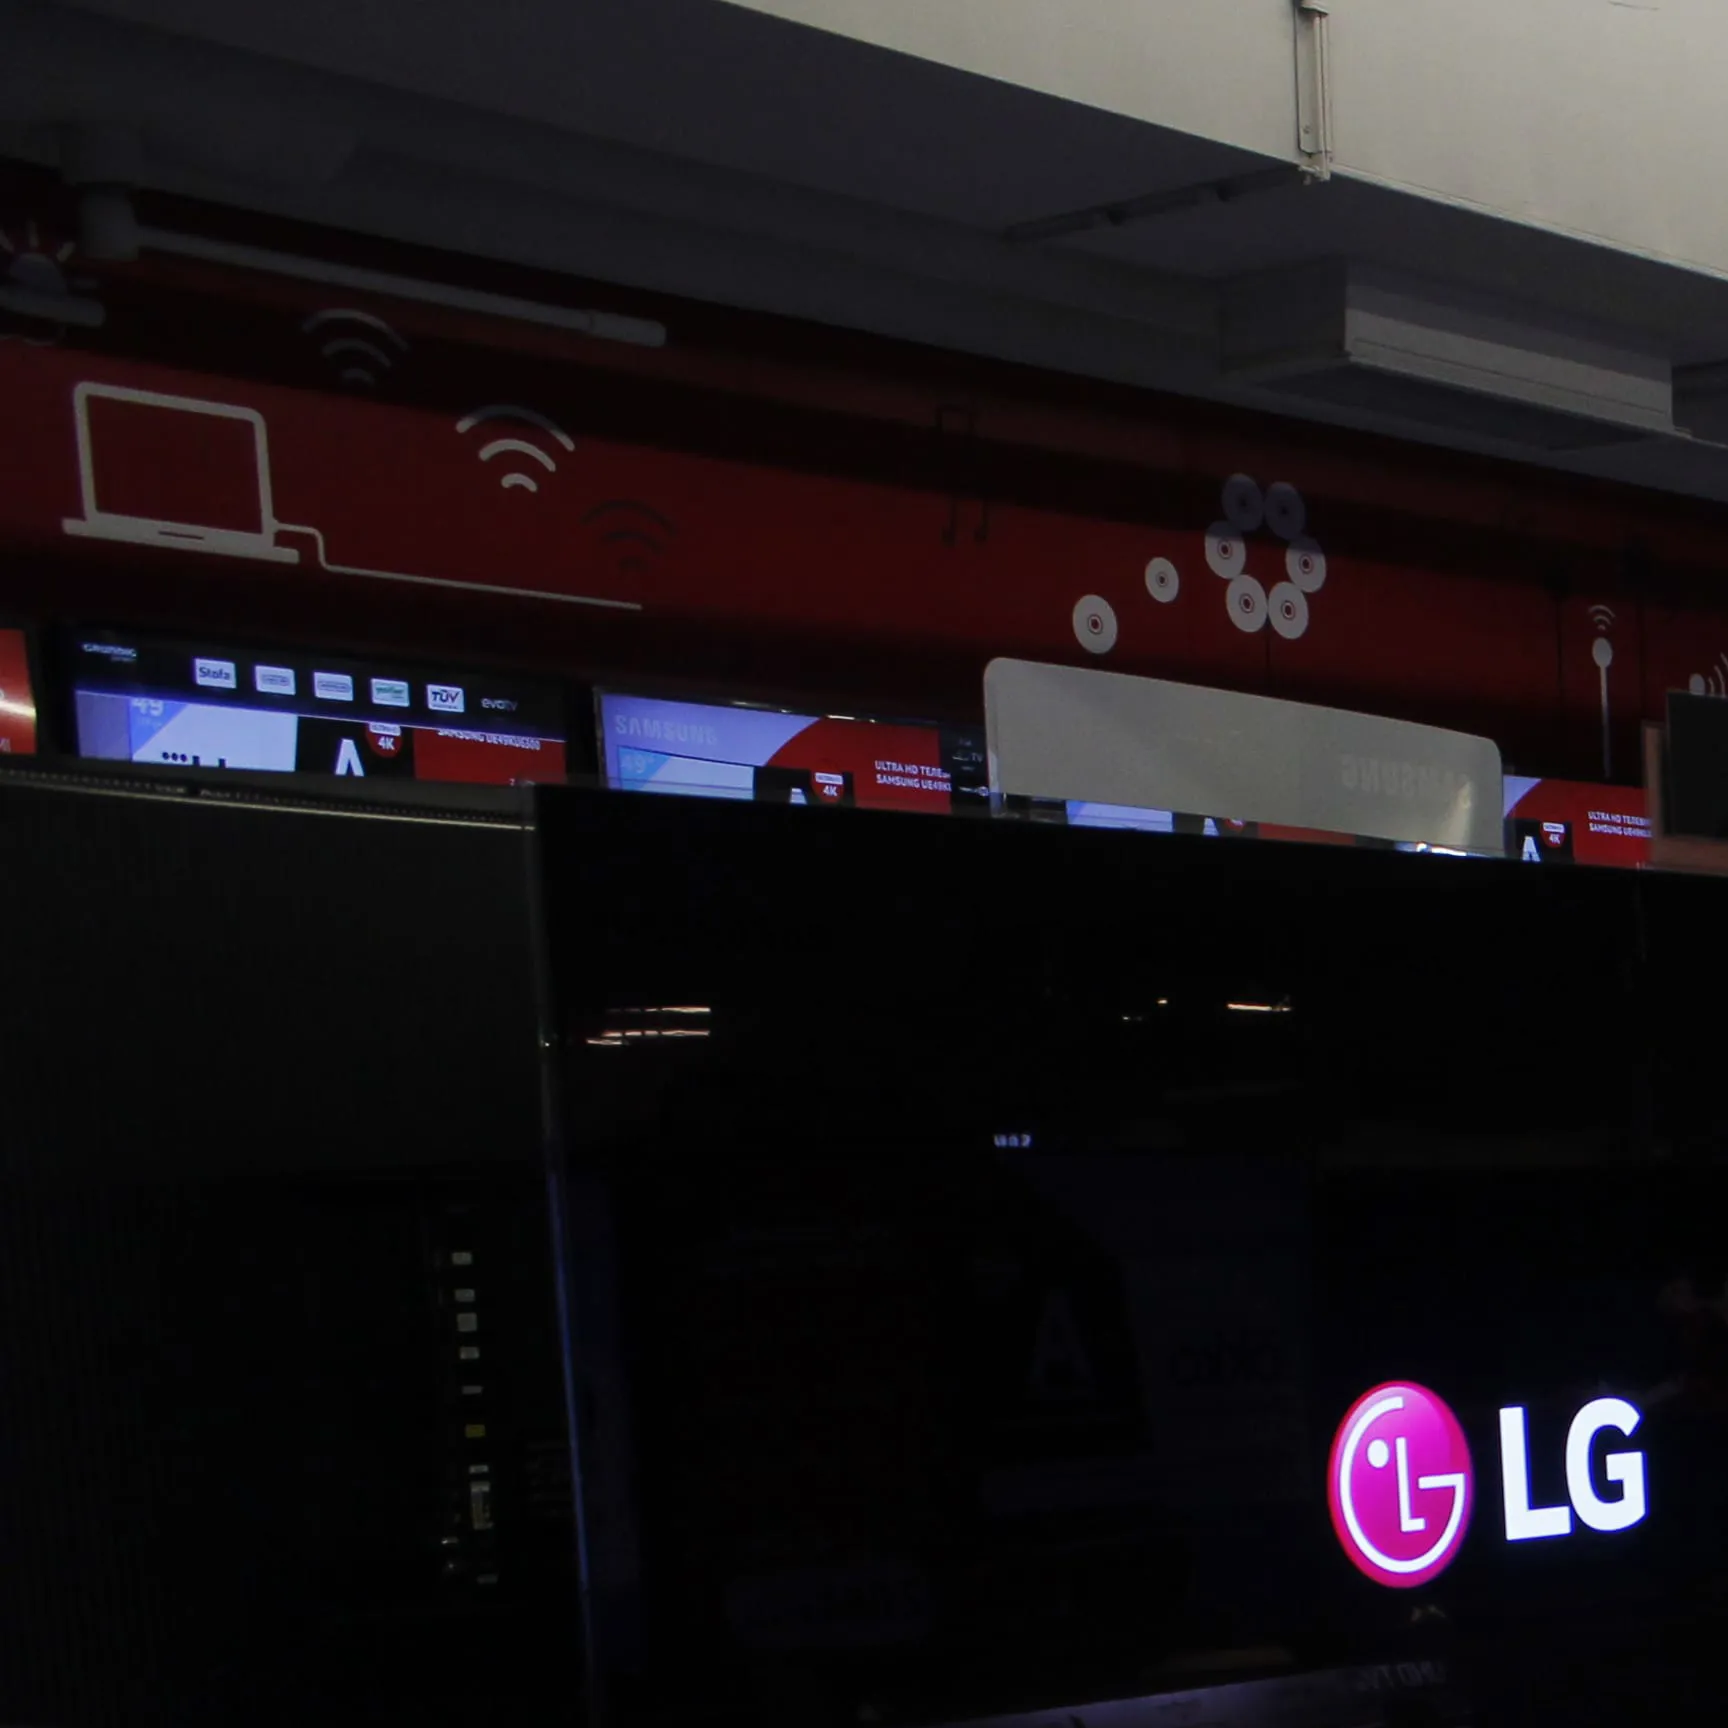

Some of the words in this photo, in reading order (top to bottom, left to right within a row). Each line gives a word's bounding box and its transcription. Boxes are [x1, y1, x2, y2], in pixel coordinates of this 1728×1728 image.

[431, 688, 460, 703] TÜV
[378, 737, 396, 750] 4K
[1500, 1397, 1647, 1541] LG
